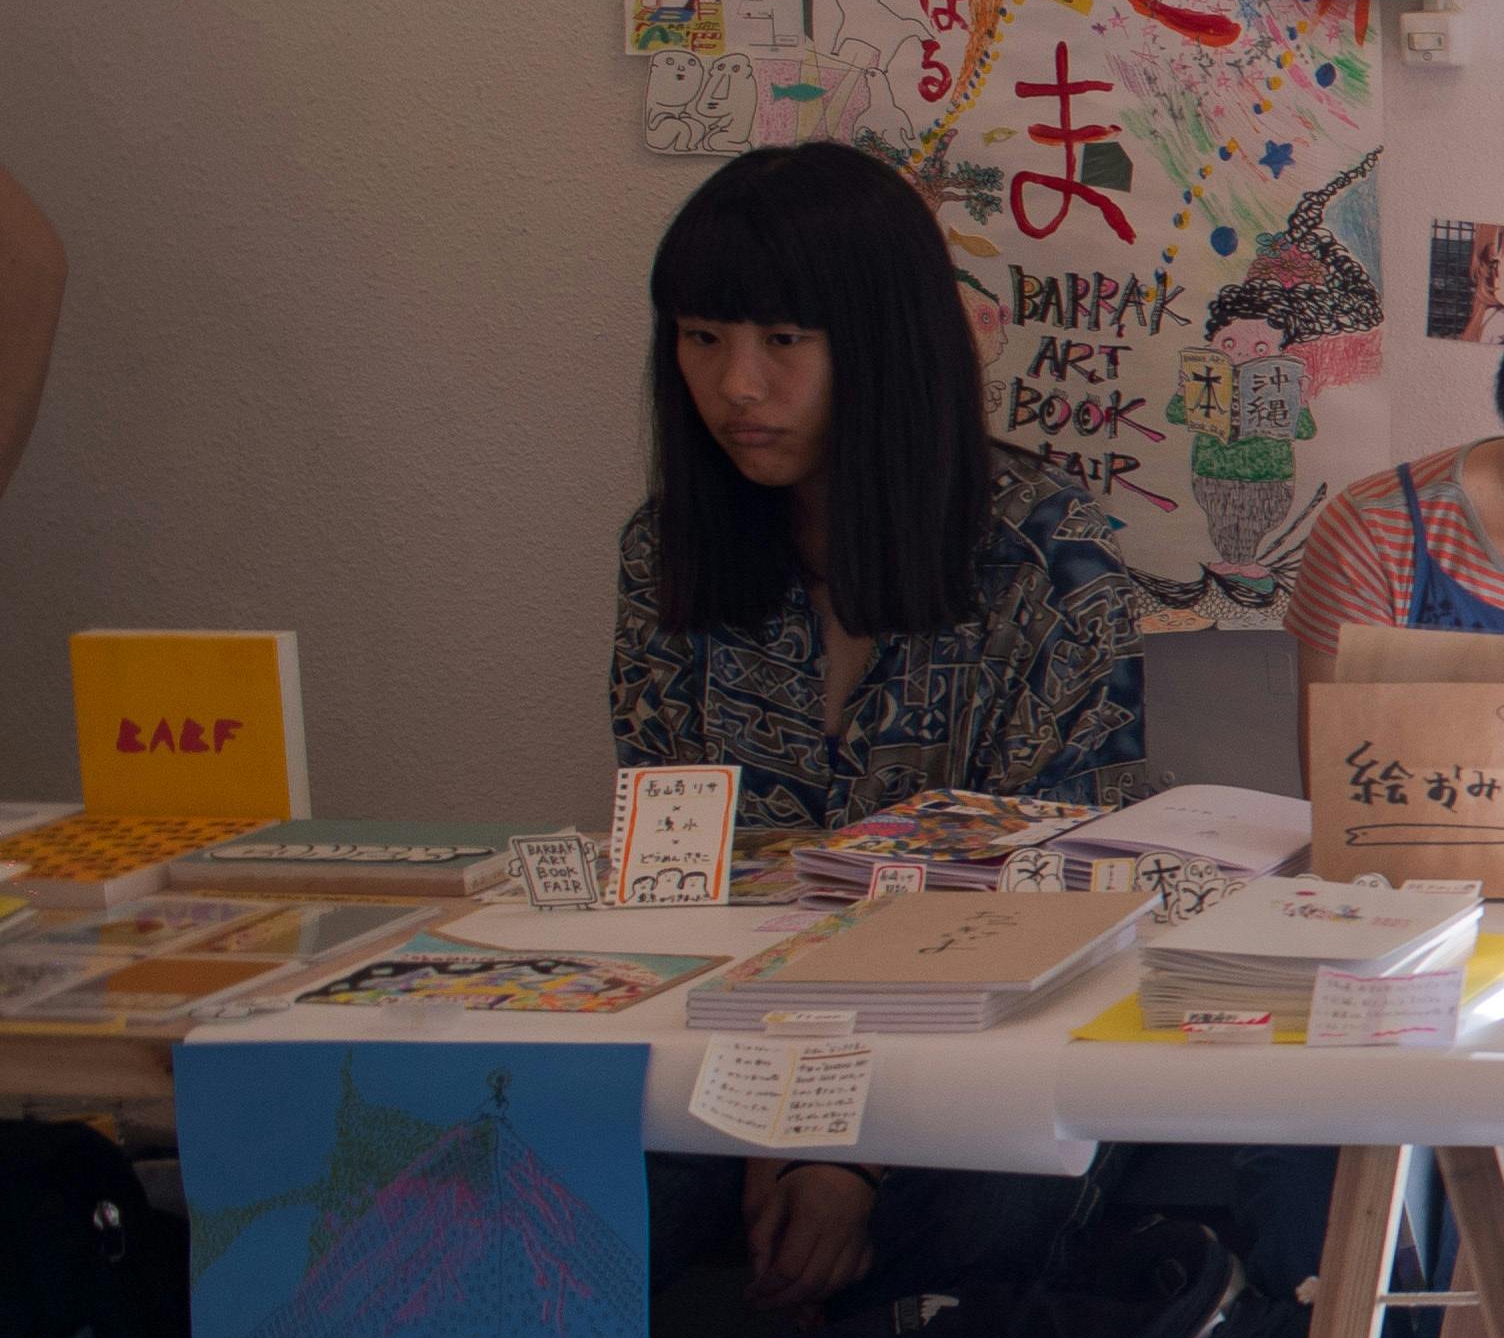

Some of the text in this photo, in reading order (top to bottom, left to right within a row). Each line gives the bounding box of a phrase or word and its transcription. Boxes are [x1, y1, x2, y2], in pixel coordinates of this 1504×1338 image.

[1008, 264, 1193, 337] BARRAK
[1026, 335, 1133, 385] ART
[1007, 376, 1167, 443] BOOK
[116, 717, 243, 754] BABF
